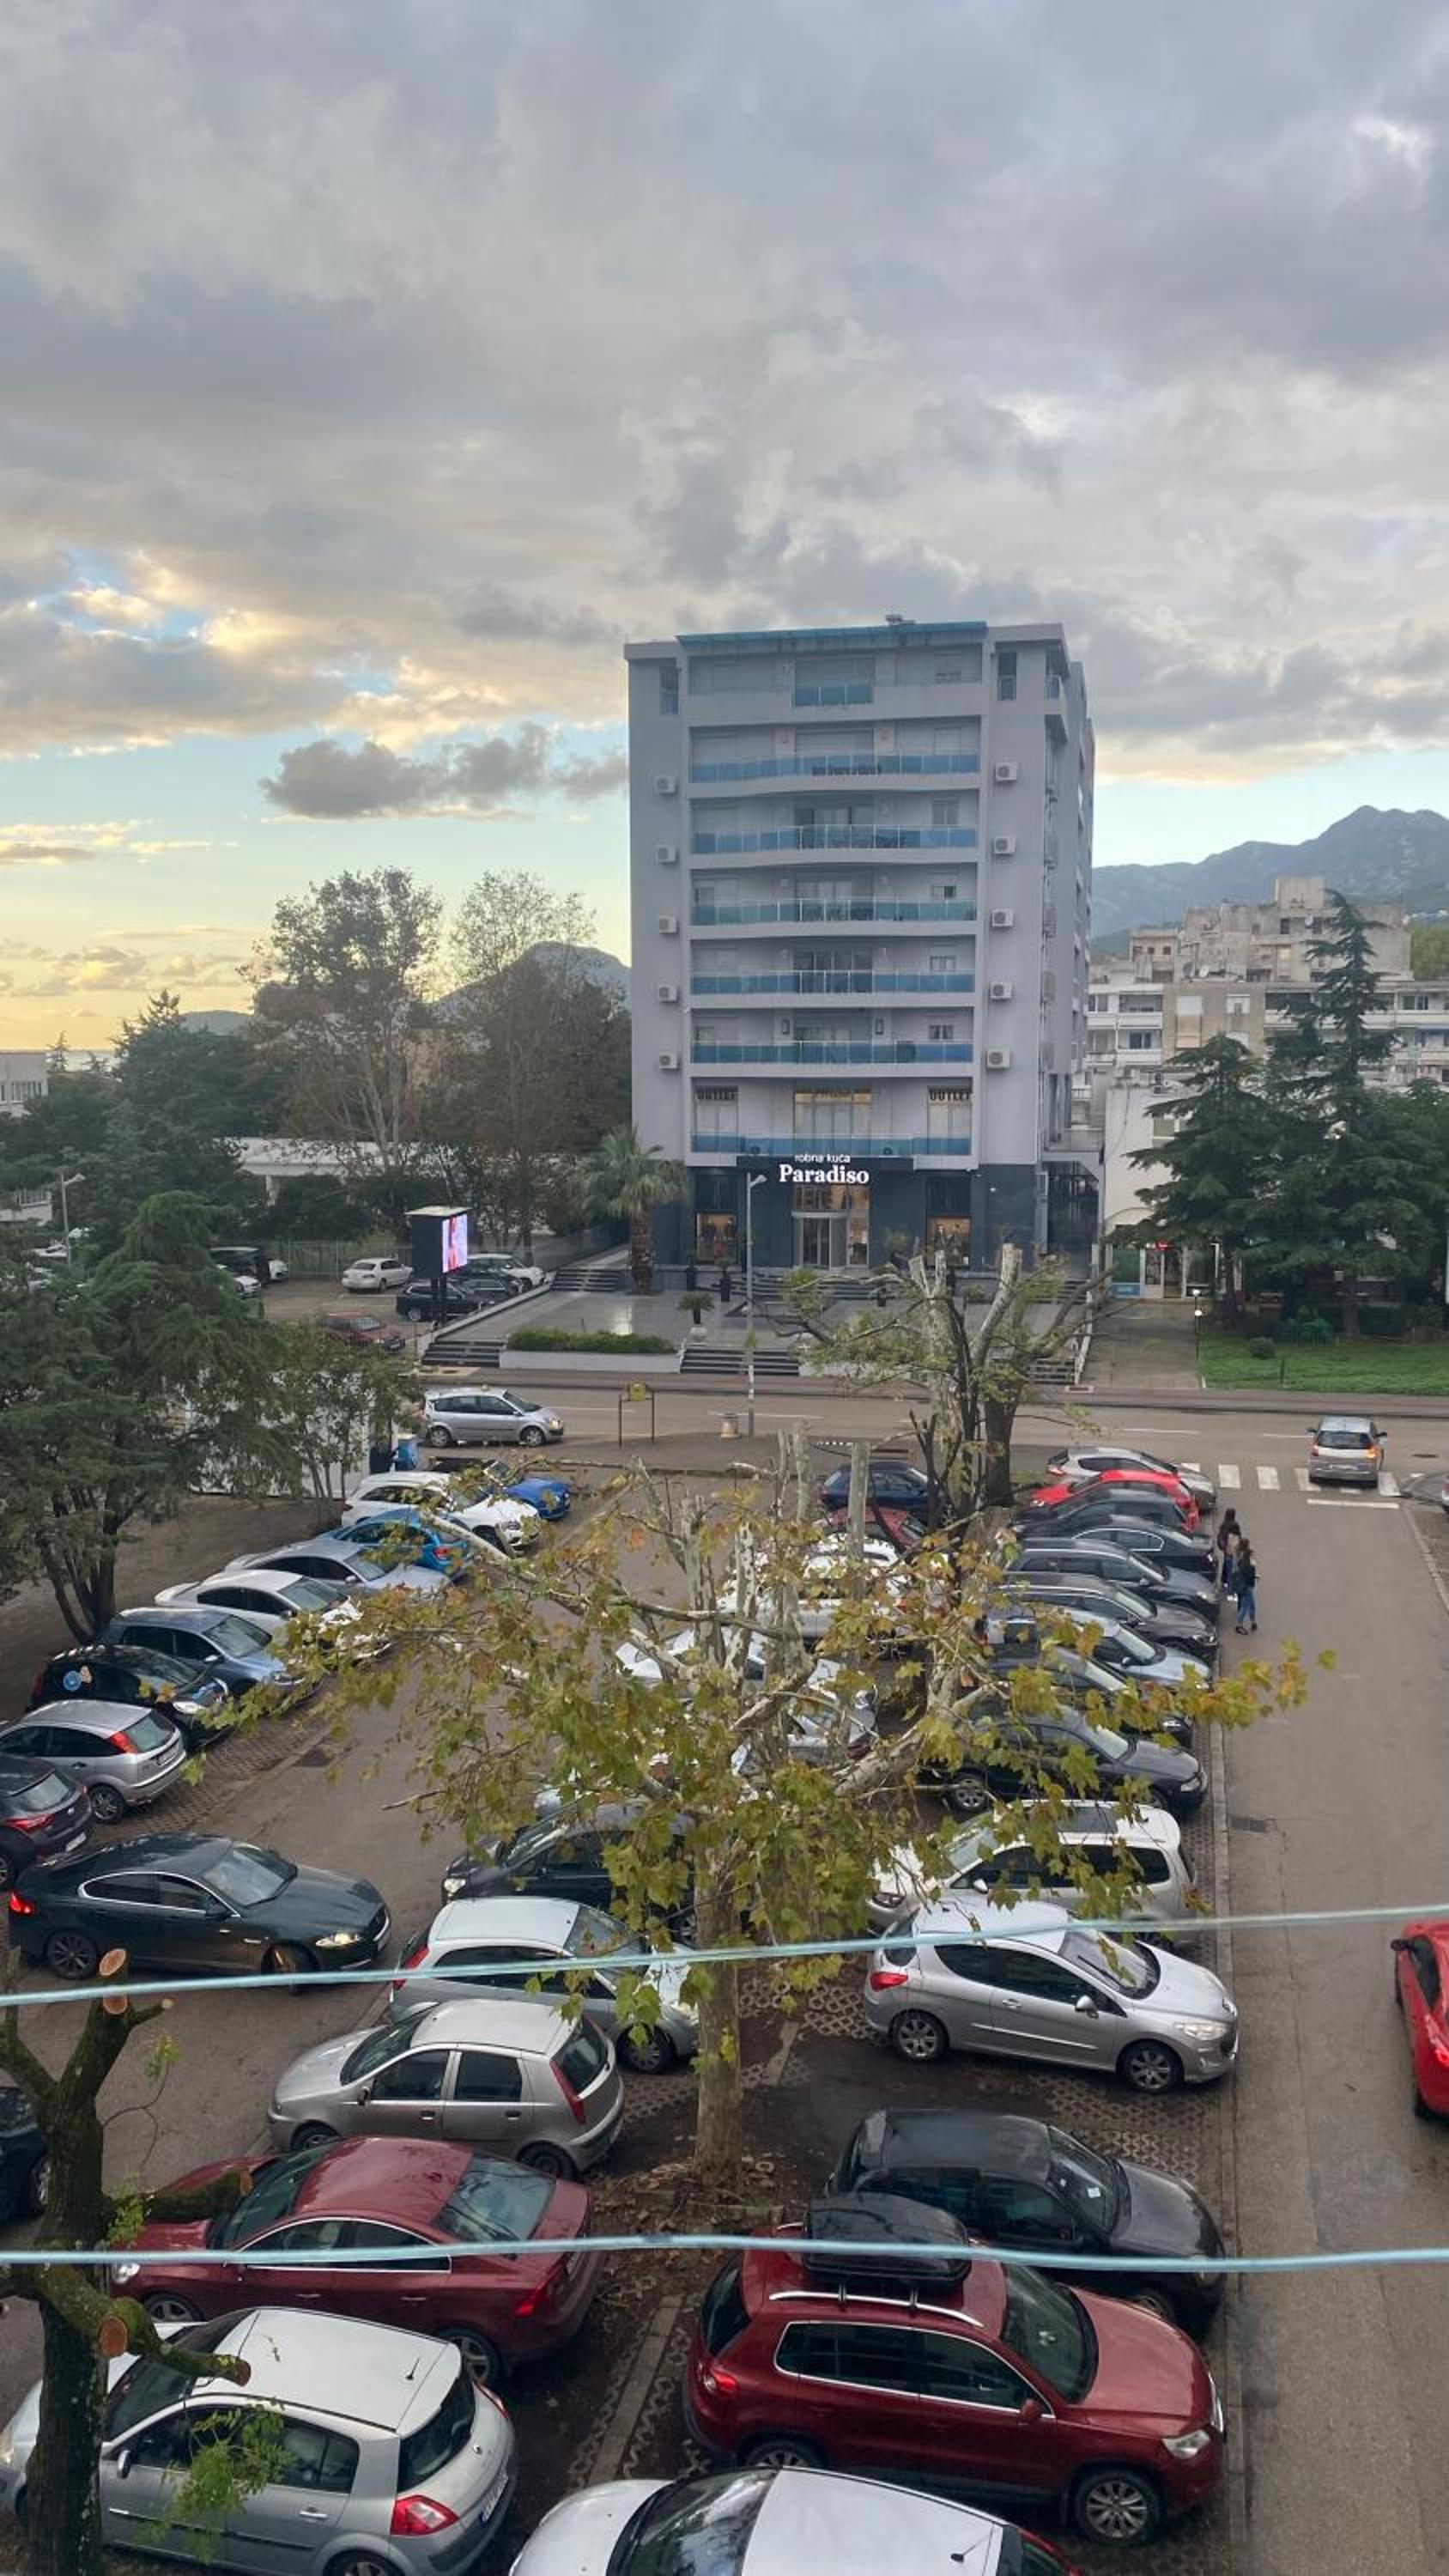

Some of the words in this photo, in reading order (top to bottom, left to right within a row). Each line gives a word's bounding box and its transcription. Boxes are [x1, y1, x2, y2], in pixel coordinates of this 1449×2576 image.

[929, 1088, 971, 1100] OUTLET
[795, 1154, 824, 1163] robna
[779, 1163, 870, 1184] Paradiso
